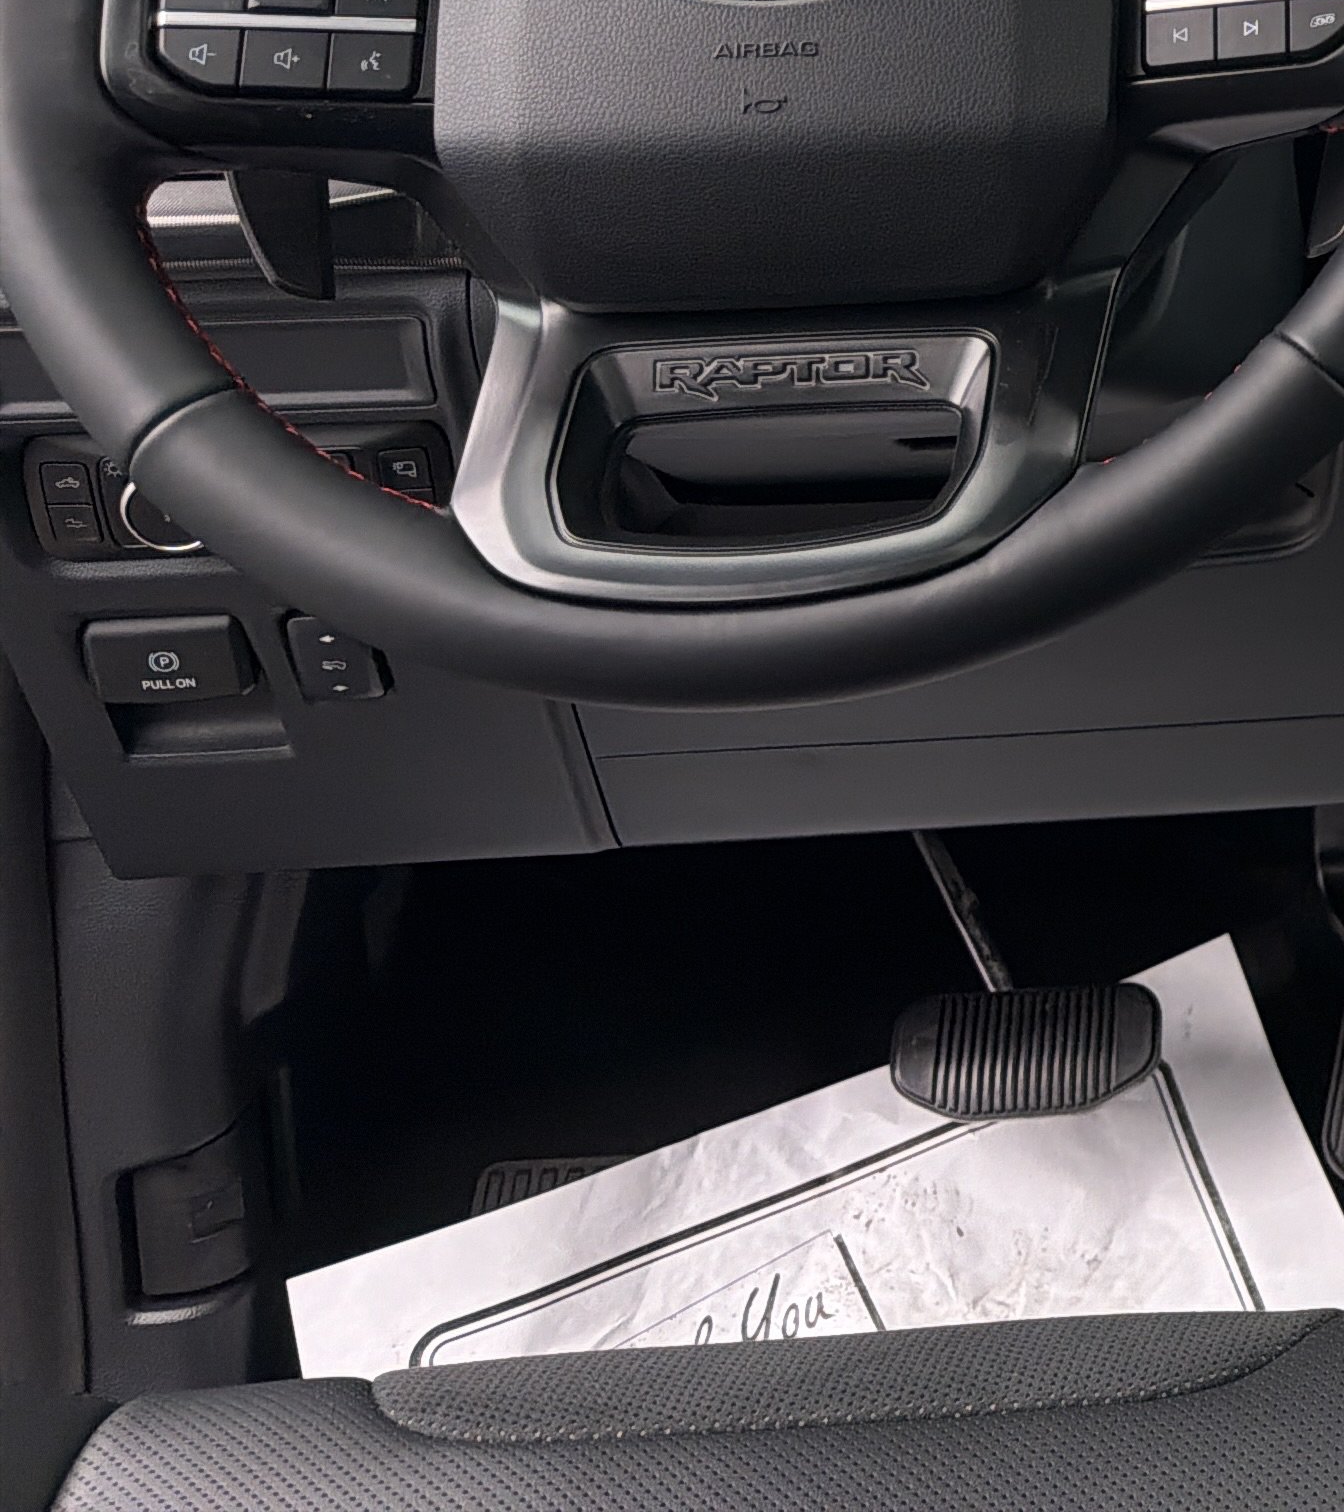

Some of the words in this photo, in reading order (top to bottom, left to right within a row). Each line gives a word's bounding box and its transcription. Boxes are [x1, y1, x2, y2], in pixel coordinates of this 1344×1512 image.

[714, 41, 819, 59] AIRBAG
[655, 348, 931, 402] RAPTOR
[141, 679, 175, 691] PULL
[175, 677, 197, 689] ON
[741, 1272, 836, 1341] You
